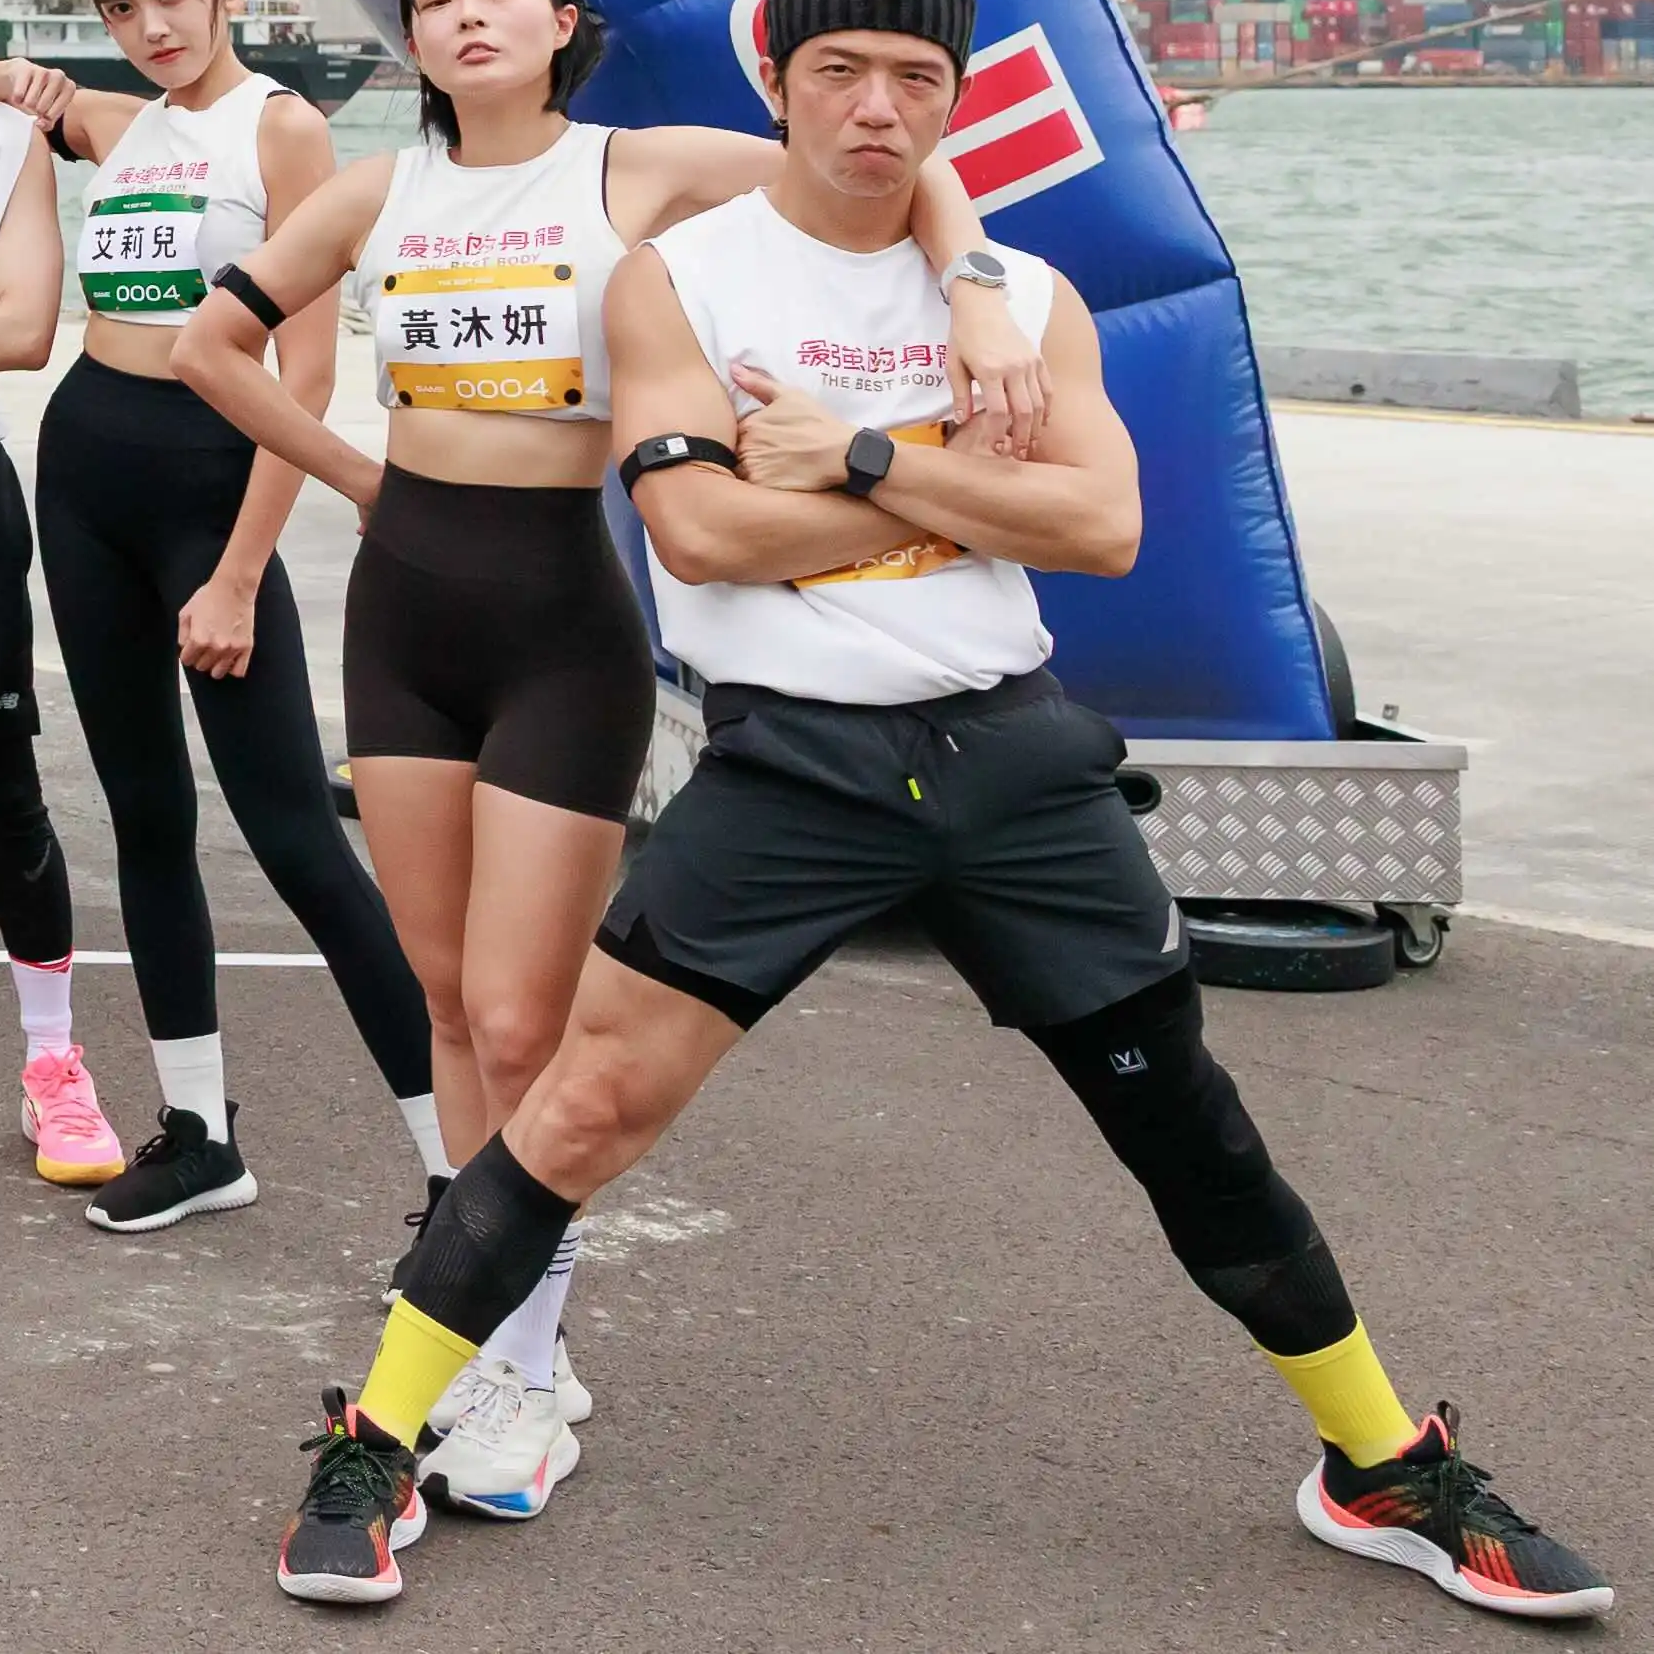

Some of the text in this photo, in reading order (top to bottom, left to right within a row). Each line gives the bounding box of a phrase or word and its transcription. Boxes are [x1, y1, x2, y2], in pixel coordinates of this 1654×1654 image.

[91, 225, 177, 261] 艾莉兒
[496, 252, 542, 268] BODY
[116, 284, 181, 302] 0004
[400, 304, 548, 351] 黃沐妍
[455, 377, 550, 400] 0004
[820, 372, 946, 393] THE BEST BODY
